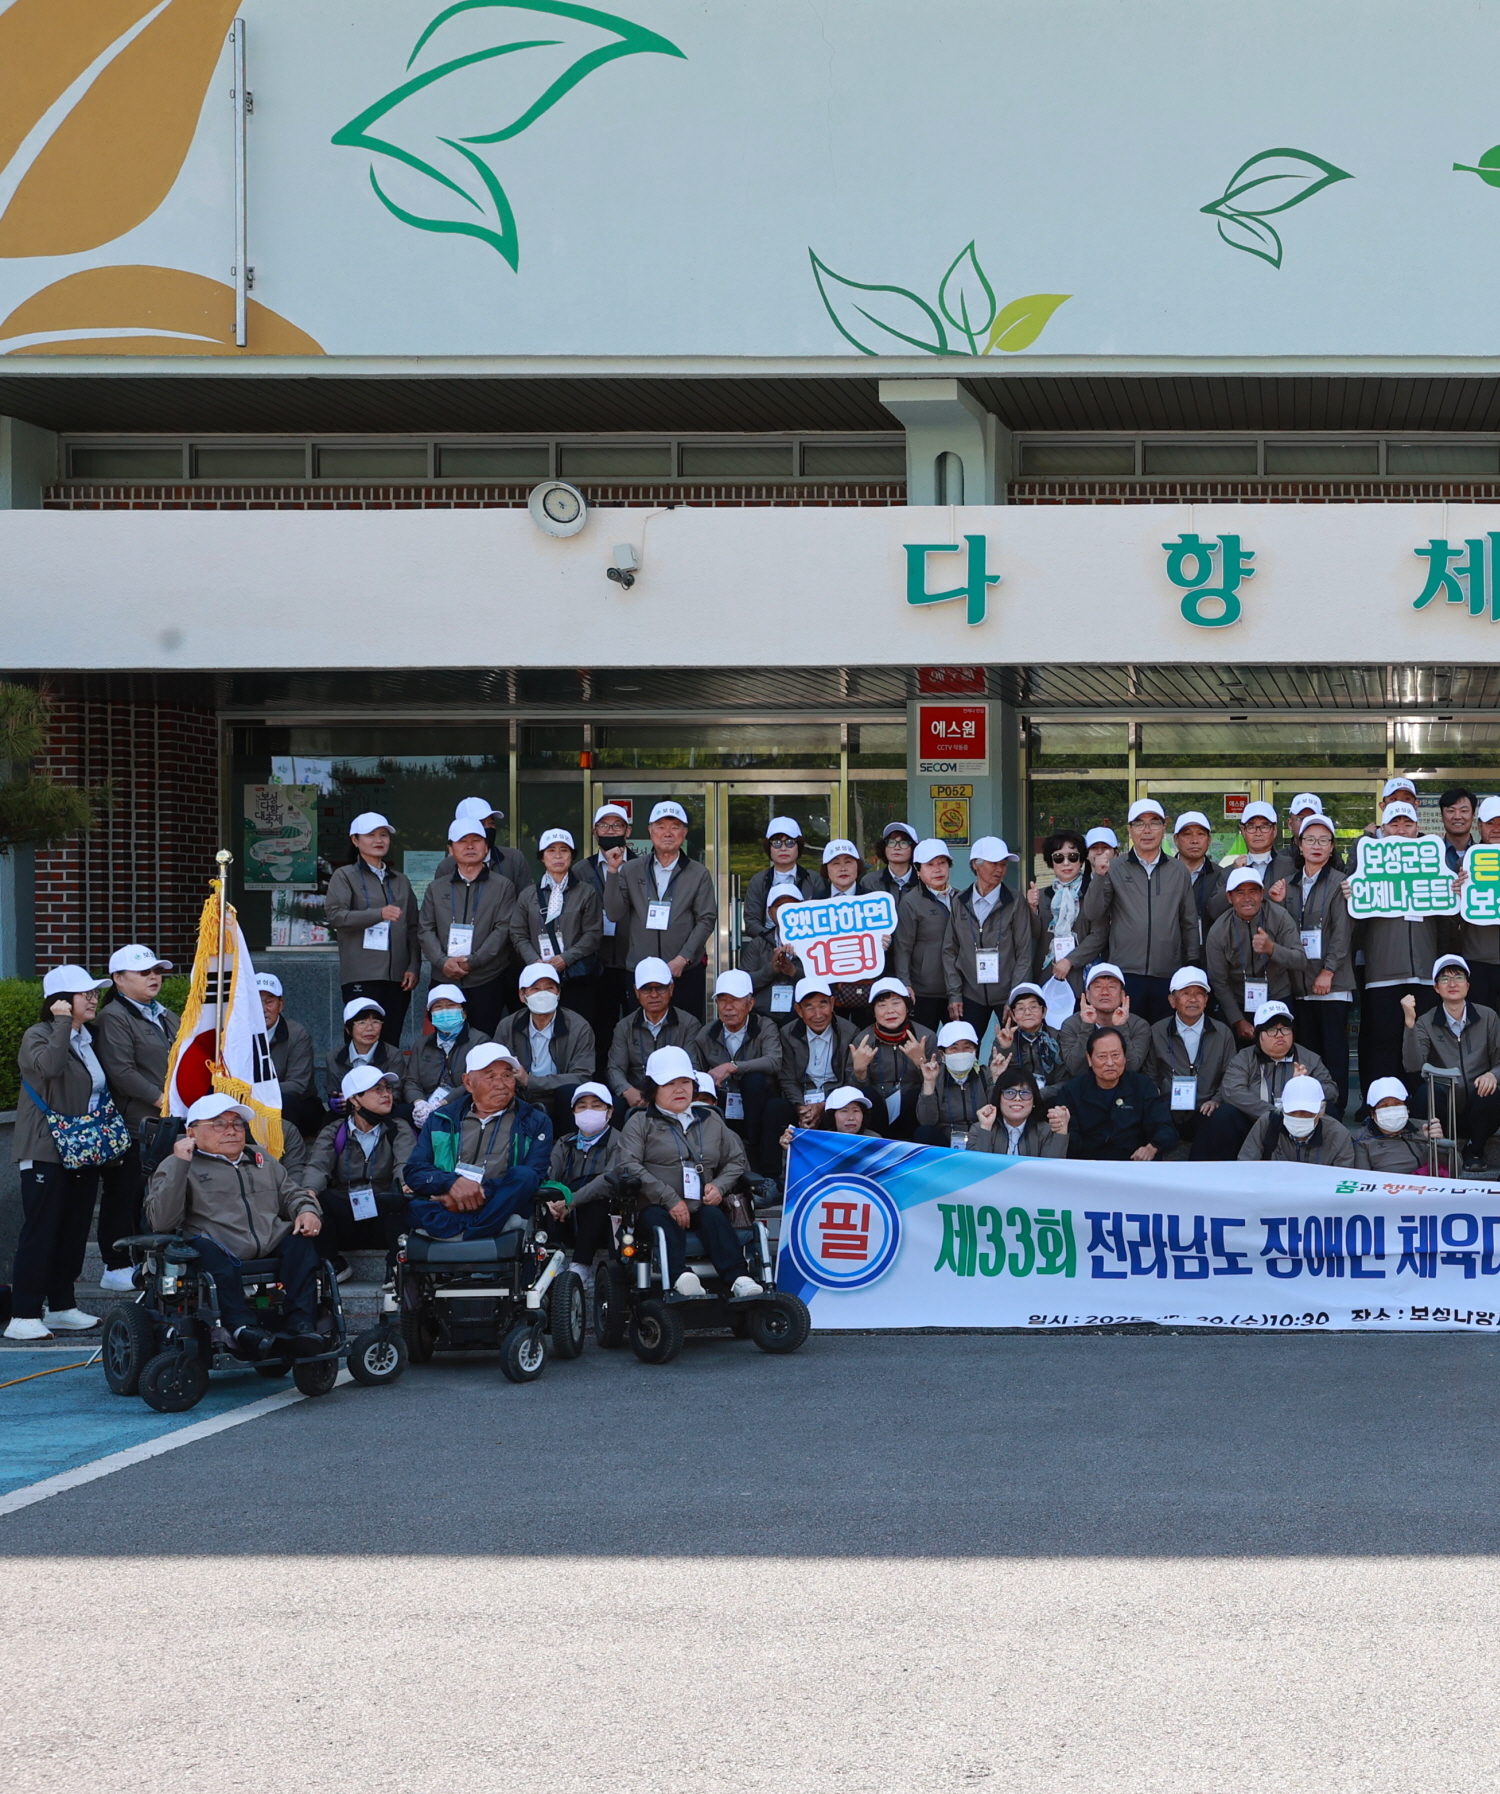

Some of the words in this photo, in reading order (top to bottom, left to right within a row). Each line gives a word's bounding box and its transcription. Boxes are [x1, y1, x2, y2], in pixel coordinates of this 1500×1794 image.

[931, 720, 975, 738] 에스원
[920, 763, 957, 773] SECOM
[937, 786, 966, 797] P052
[1364, 843, 1440, 875] 보성군은
[1352, 879, 1409, 910] 언제나
[1411, 878, 1455, 909] 든든!
[783, 899, 892, 939] 했다하면
[808, 935, 876, 975] 1등!
[1335, 1180, 1378, 1194] 꿈과
[817, 1201, 869, 1260] 필
[934, 1202, 1077, 1279] 제33회
[1084, 1210, 1254, 1280] 전라남도
[1259, 1213, 1387, 1279] 장애인
[1028, 1314, 1069, 1325] 일시
[1351, 1307, 1391, 1322] 장소
